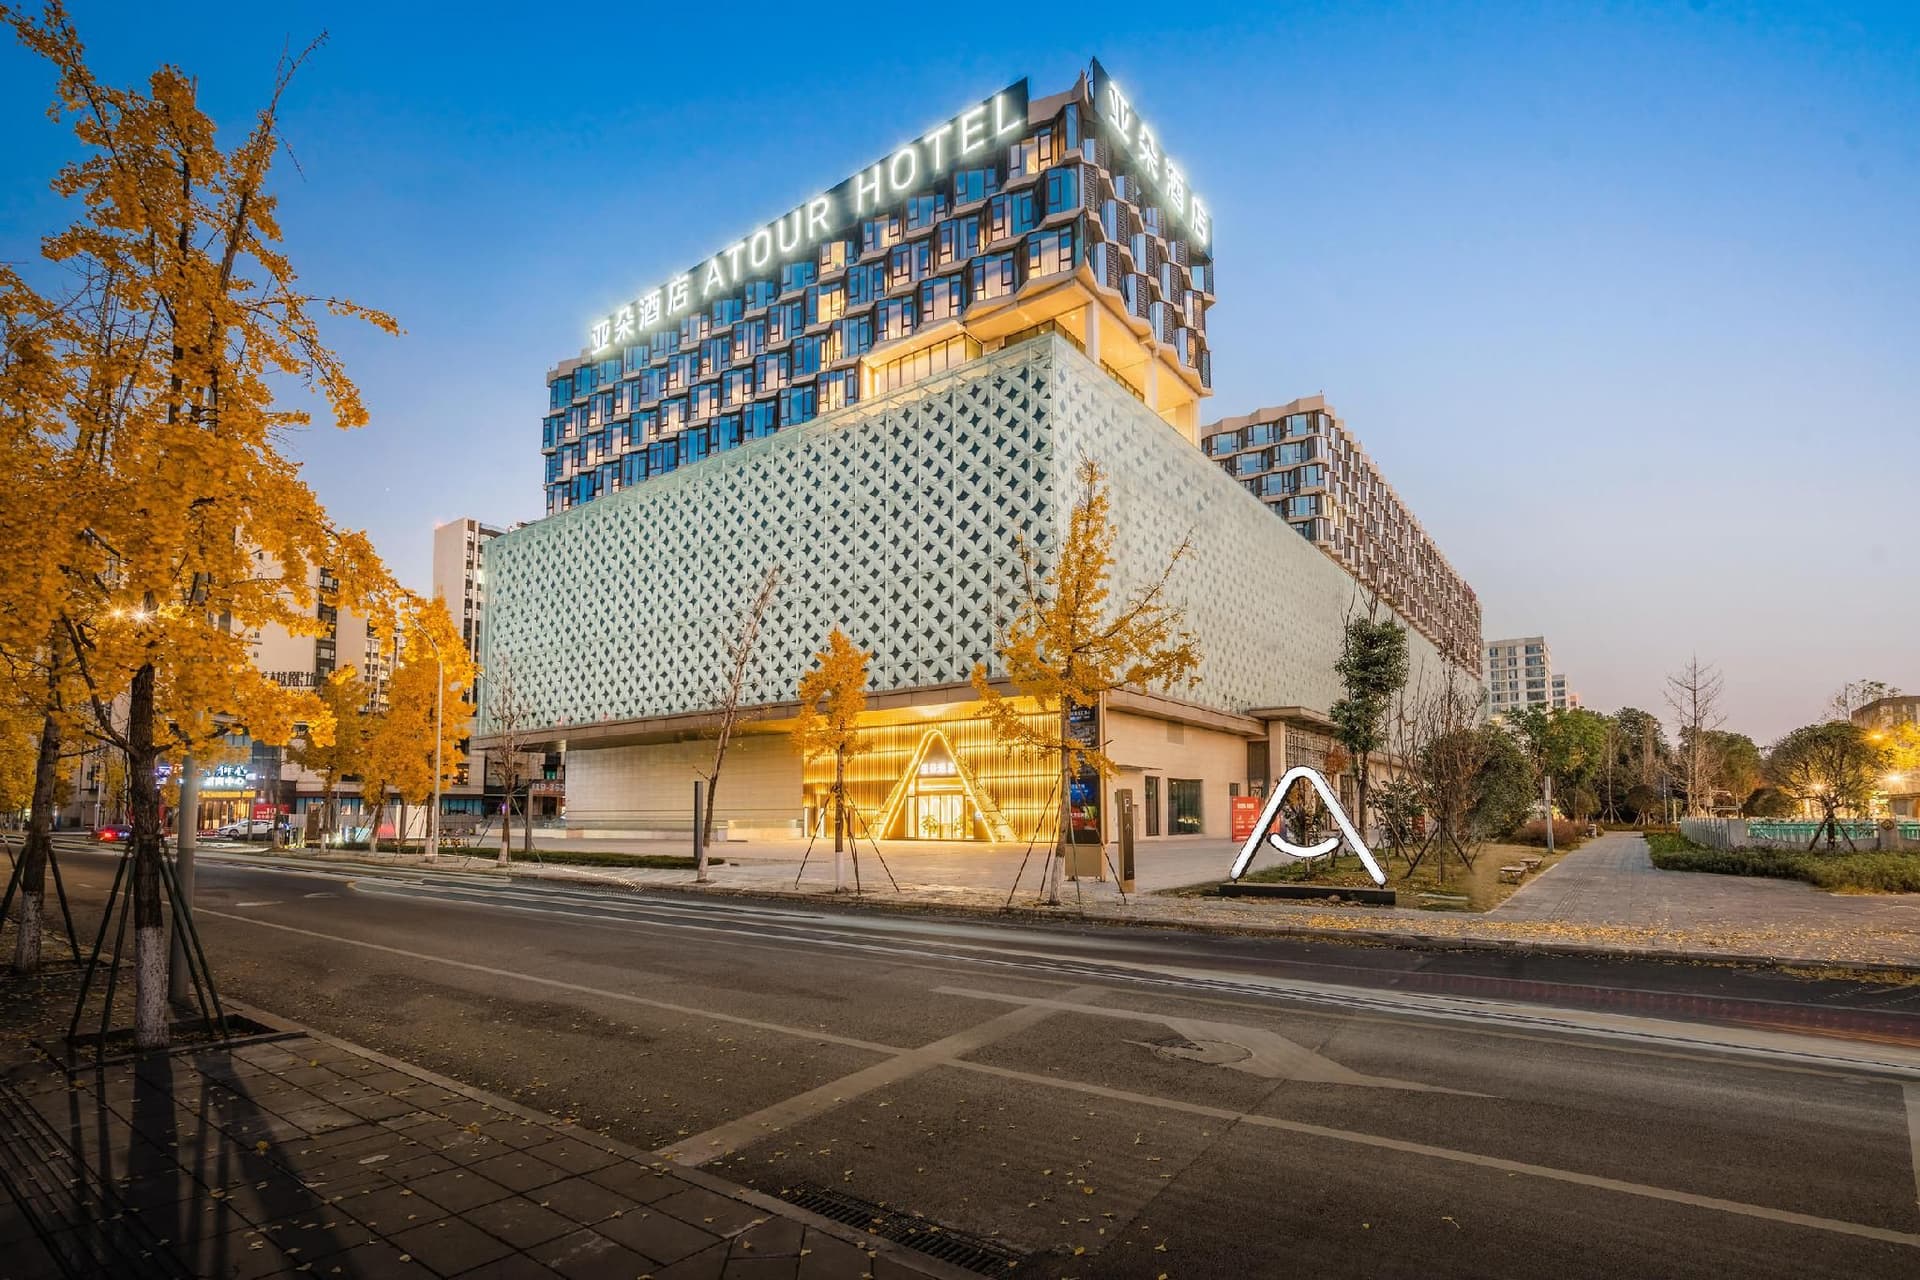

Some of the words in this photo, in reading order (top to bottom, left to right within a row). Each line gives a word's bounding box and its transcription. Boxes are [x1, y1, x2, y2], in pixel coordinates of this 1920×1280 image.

[591, 274, 689, 355] 亚朵酒店
[702, 196, 831, 297] ATOUR
[856, 94, 1022, 214] HOTEL
[1108, 80, 1209, 247] 亚朵酒店
